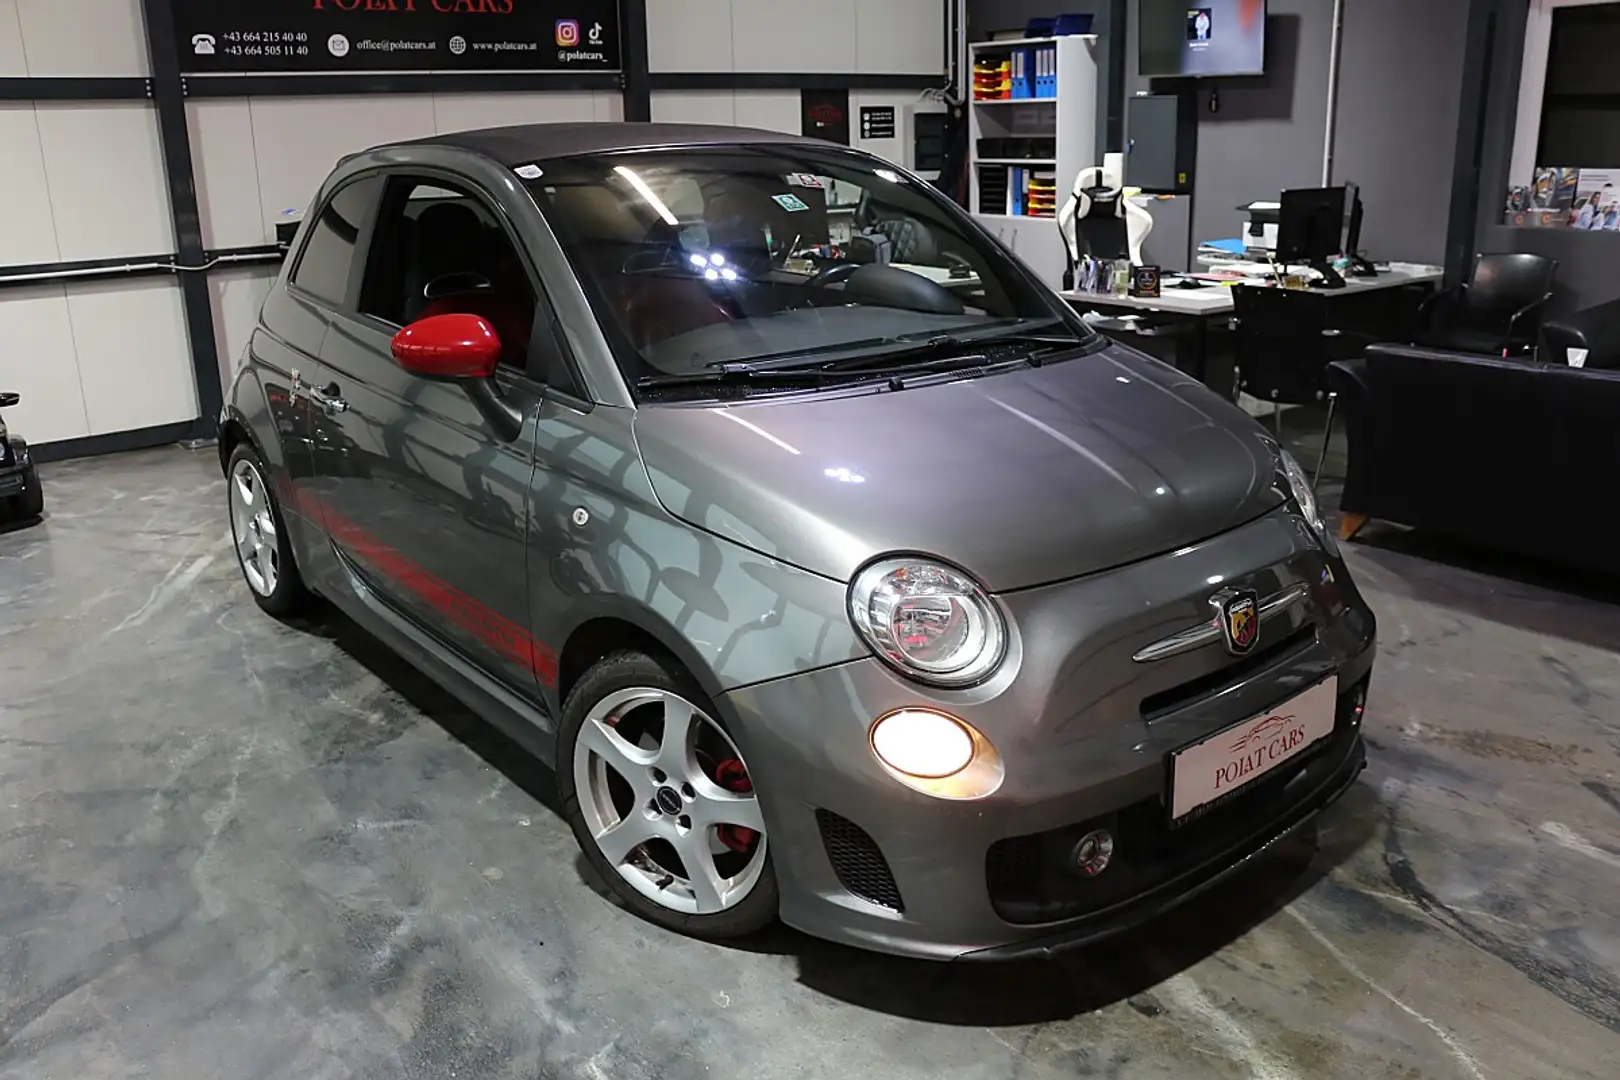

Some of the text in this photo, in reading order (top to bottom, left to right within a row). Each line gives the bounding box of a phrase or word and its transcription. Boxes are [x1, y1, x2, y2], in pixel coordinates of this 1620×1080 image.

[223, 31, 308, 42] +43 664 215 40 40
[224, 45, 308, 55] +43 664 505 11 40
[356, 39, 436, 52] office@polatcars.at
[472, 41, 537, 52] www.polatcars.at
[1268, 724, 1305, 760] CARS
